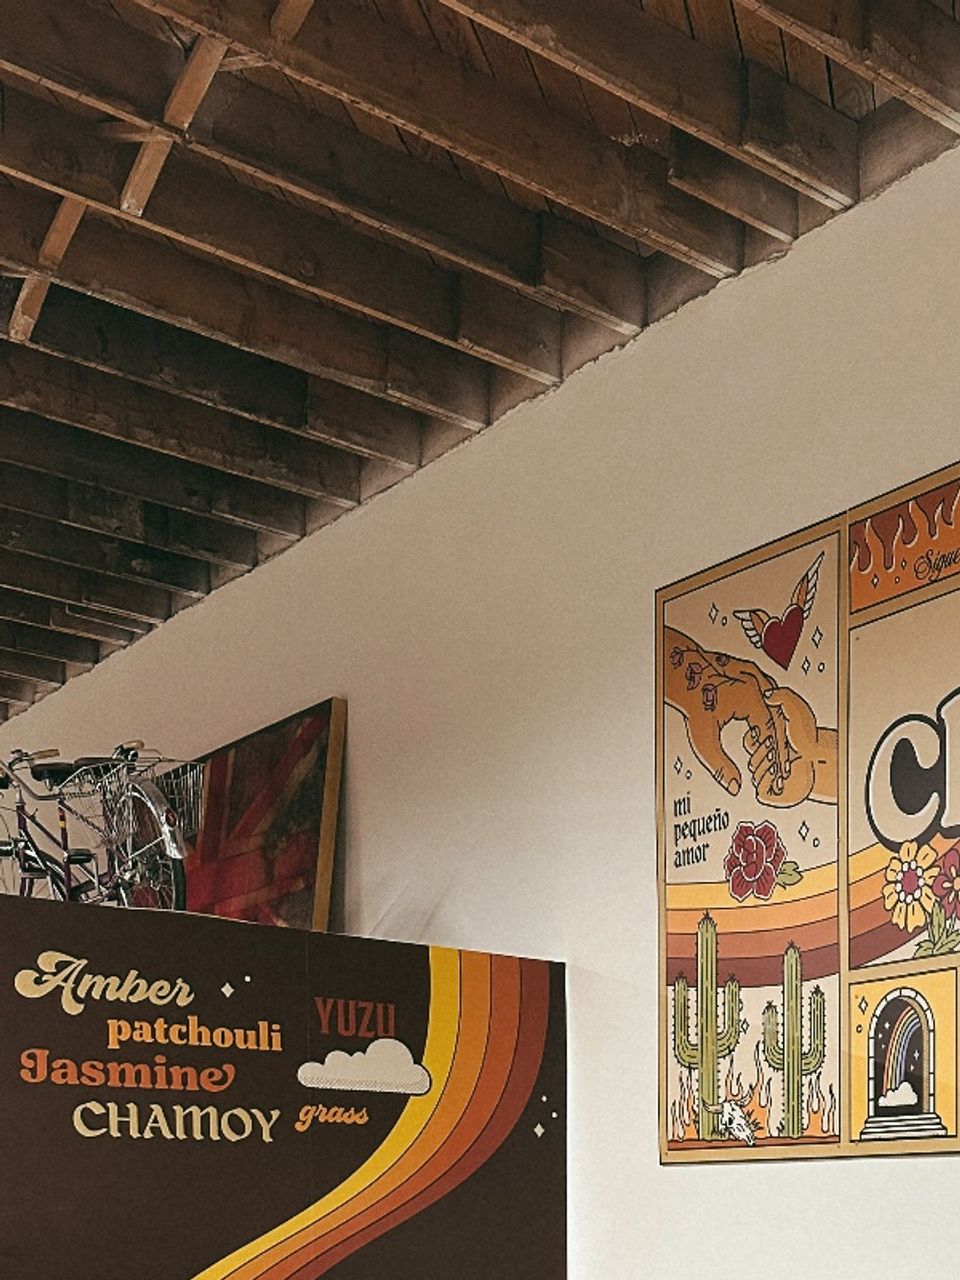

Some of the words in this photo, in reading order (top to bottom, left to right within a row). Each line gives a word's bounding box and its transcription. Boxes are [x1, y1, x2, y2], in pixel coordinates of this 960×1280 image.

[673, 791, 691, 817] mi
[673, 808, 730, 847] pequeño
[673, 843, 710, 869] amor
[14, 950, 195, 1016] Amber
[107, 1014, 283, 1051] patchouli
[313, 996, 397, 1039] YUZU
[19, 1048, 236, 1093] Jasmine
[72, 1100, 282, 1143] CHAMOY
[294, 1102, 370, 1133] grass
